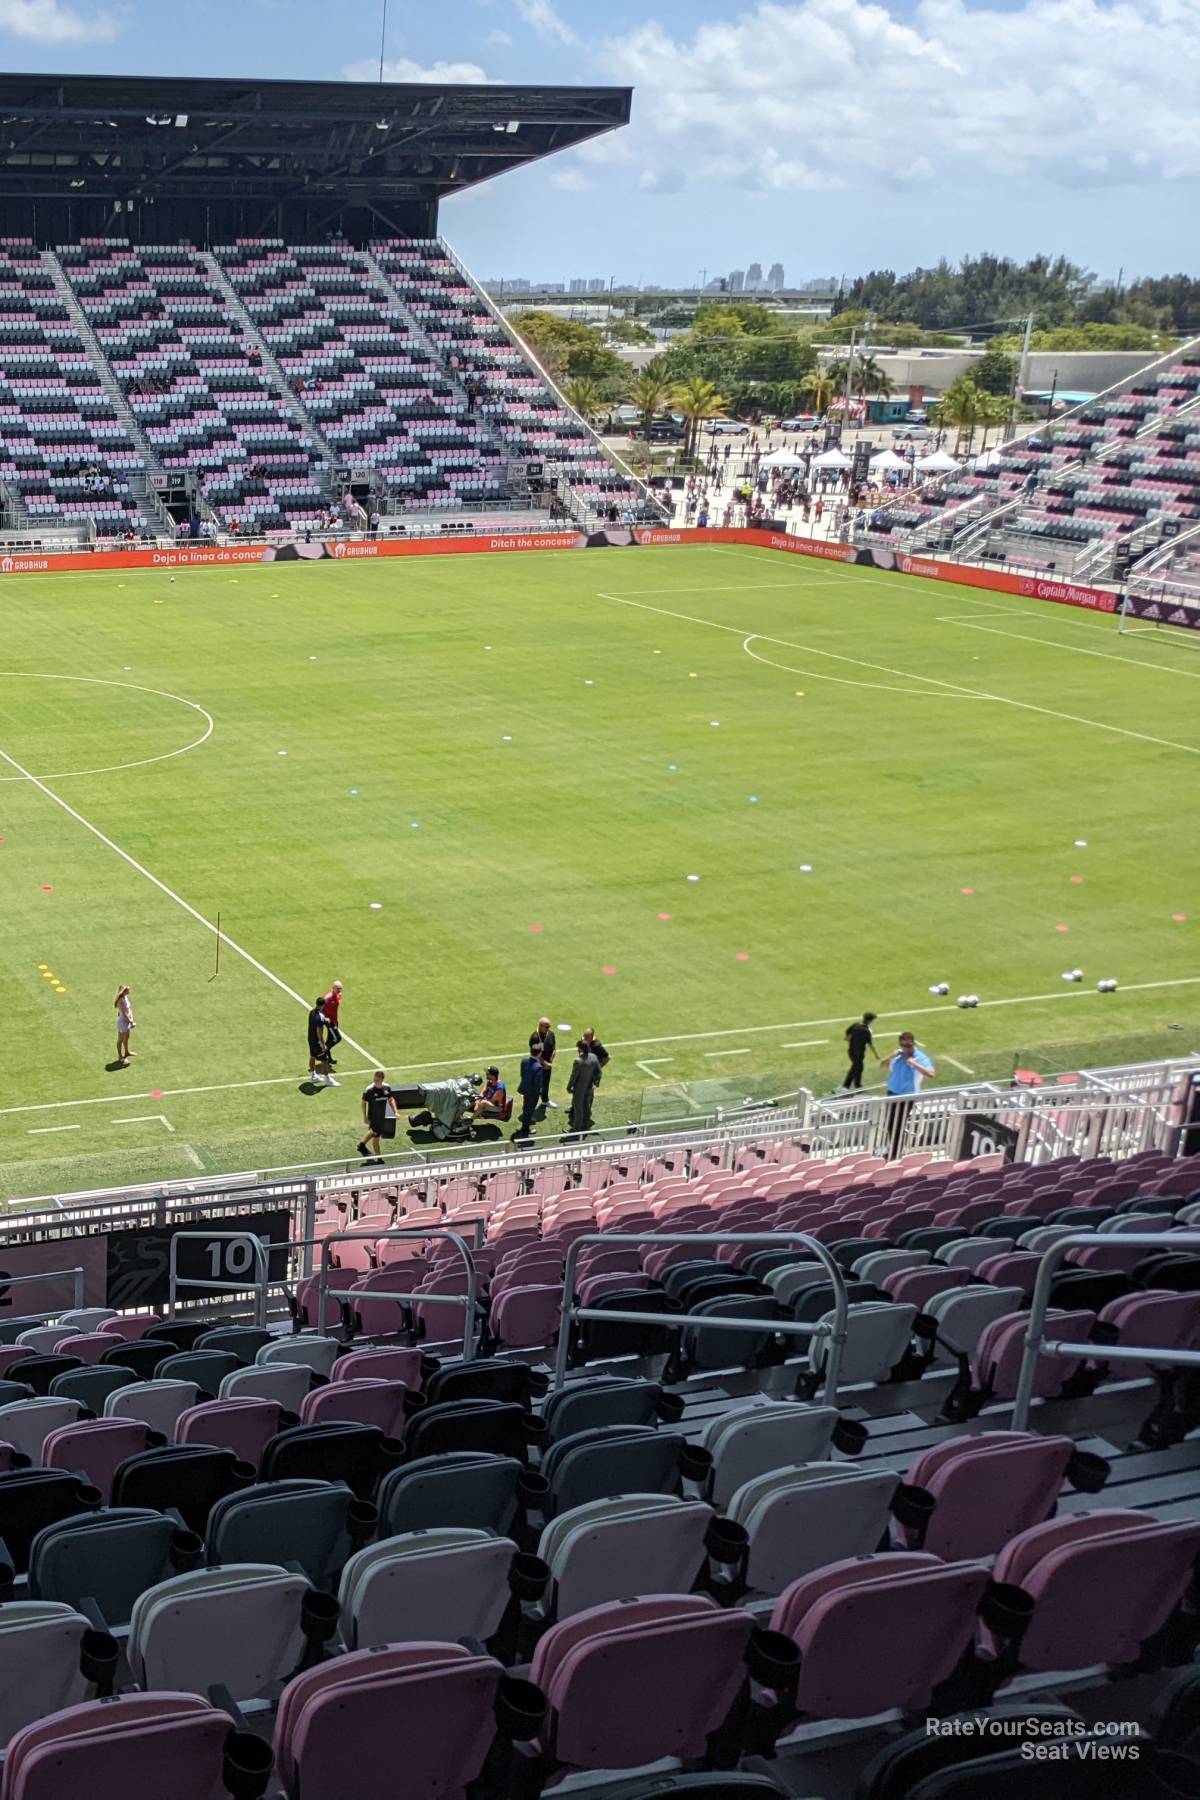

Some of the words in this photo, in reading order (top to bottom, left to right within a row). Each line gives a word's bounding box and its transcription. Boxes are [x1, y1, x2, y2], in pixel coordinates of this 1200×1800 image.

[490, 538, 514, 548] Ditch
[517, 538, 532, 548] the
[346, 546, 378, 555] GRUBHUB
[825, 548, 848, 558] conce
[152, 554, 176, 565] Deja
[178, 553, 188, 562] la
[190, 552, 212, 562] línea
[214, 551, 230, 560] de
[232, 551, 264, 560] conce
[14, 560, 48, 570] GRUBHUB
[1038, 582, 1066, 598] Captain
[1065, 586, 1097, 606] Morgan
